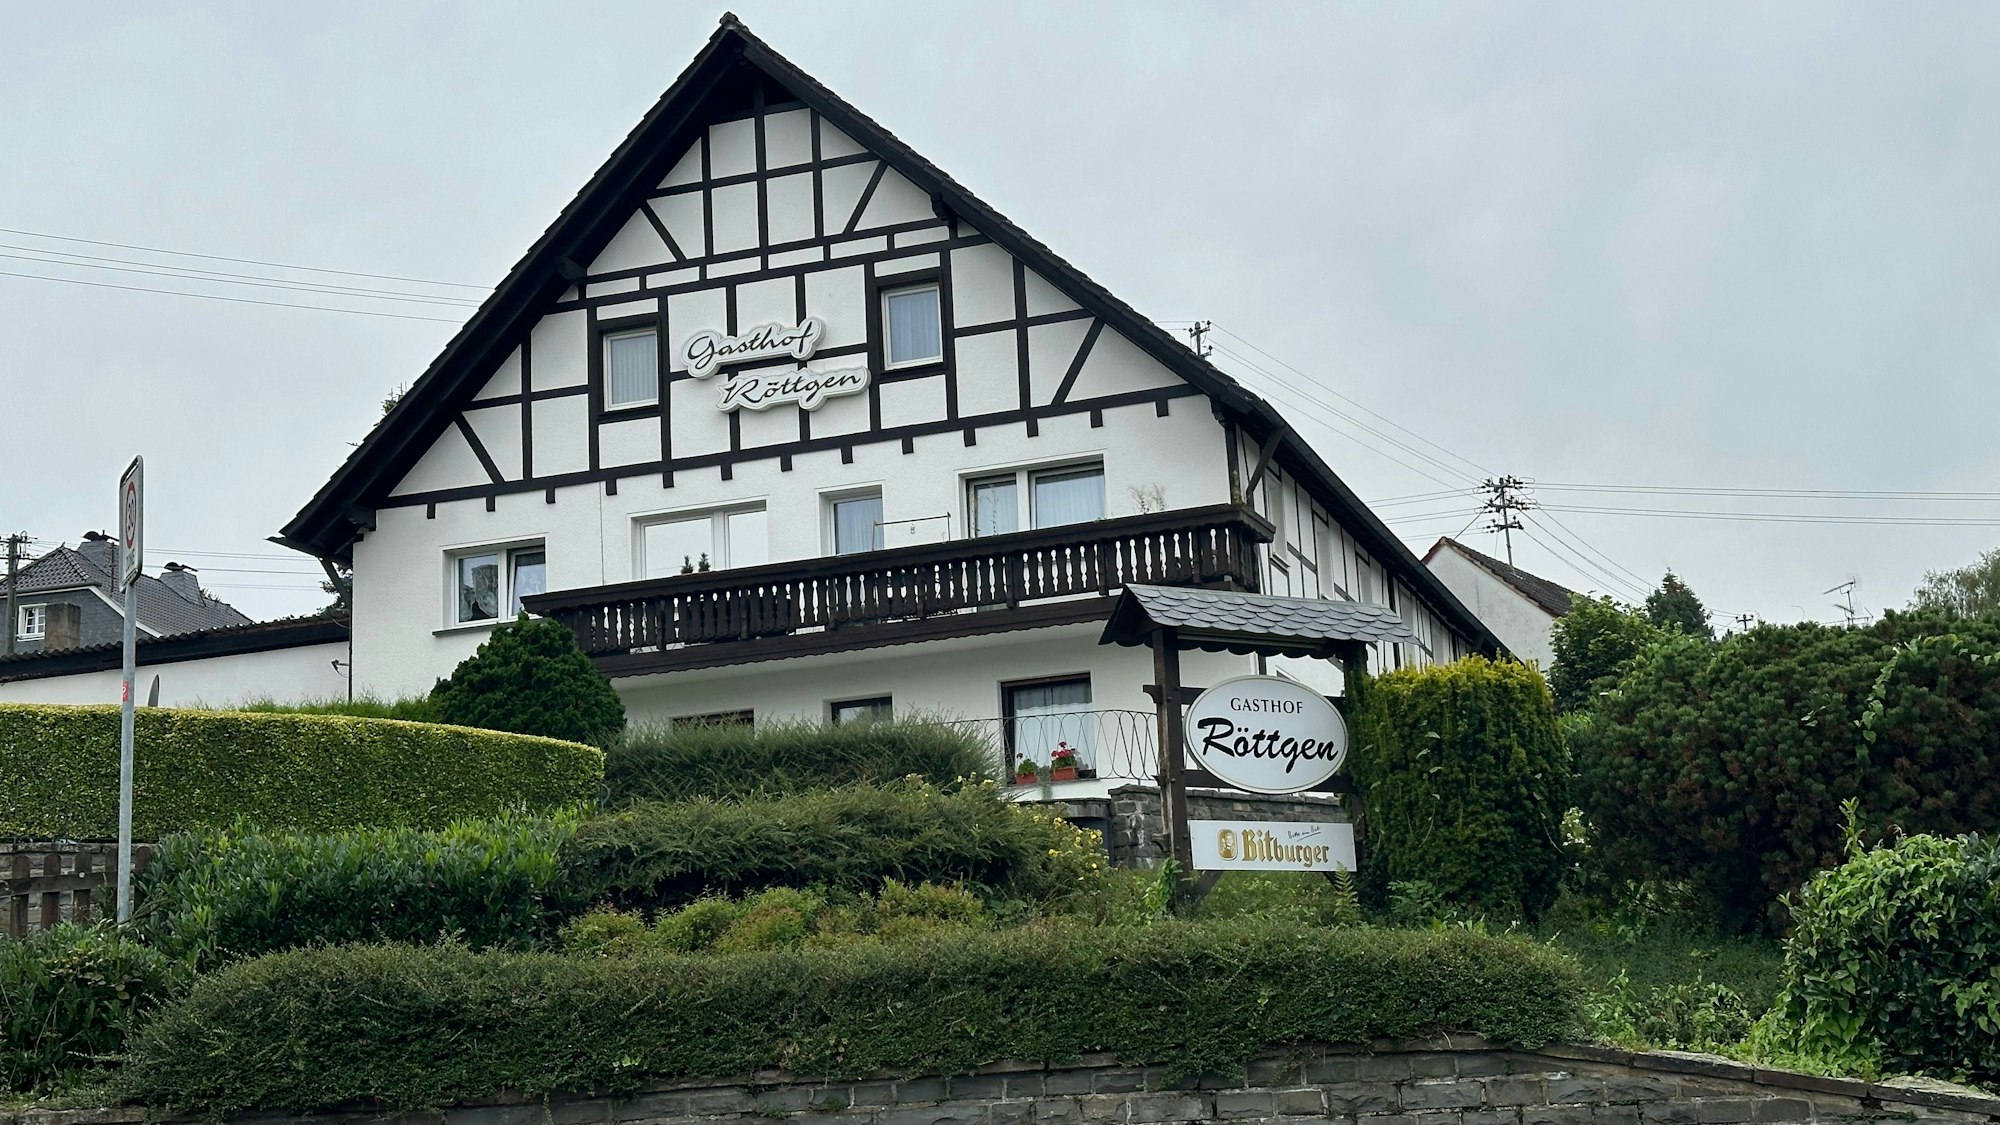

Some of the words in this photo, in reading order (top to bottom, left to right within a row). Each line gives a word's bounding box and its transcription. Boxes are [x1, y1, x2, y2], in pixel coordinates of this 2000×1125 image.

[687, 321, 814, 370] Gasthof
[723, 372, 861, 404] Röttgen
[1230, 697, 1303, 714] GASTHOF
[1197, 717, 1339, 774] Röttgen
[1241, 828, 1330, 867] Bitburger
